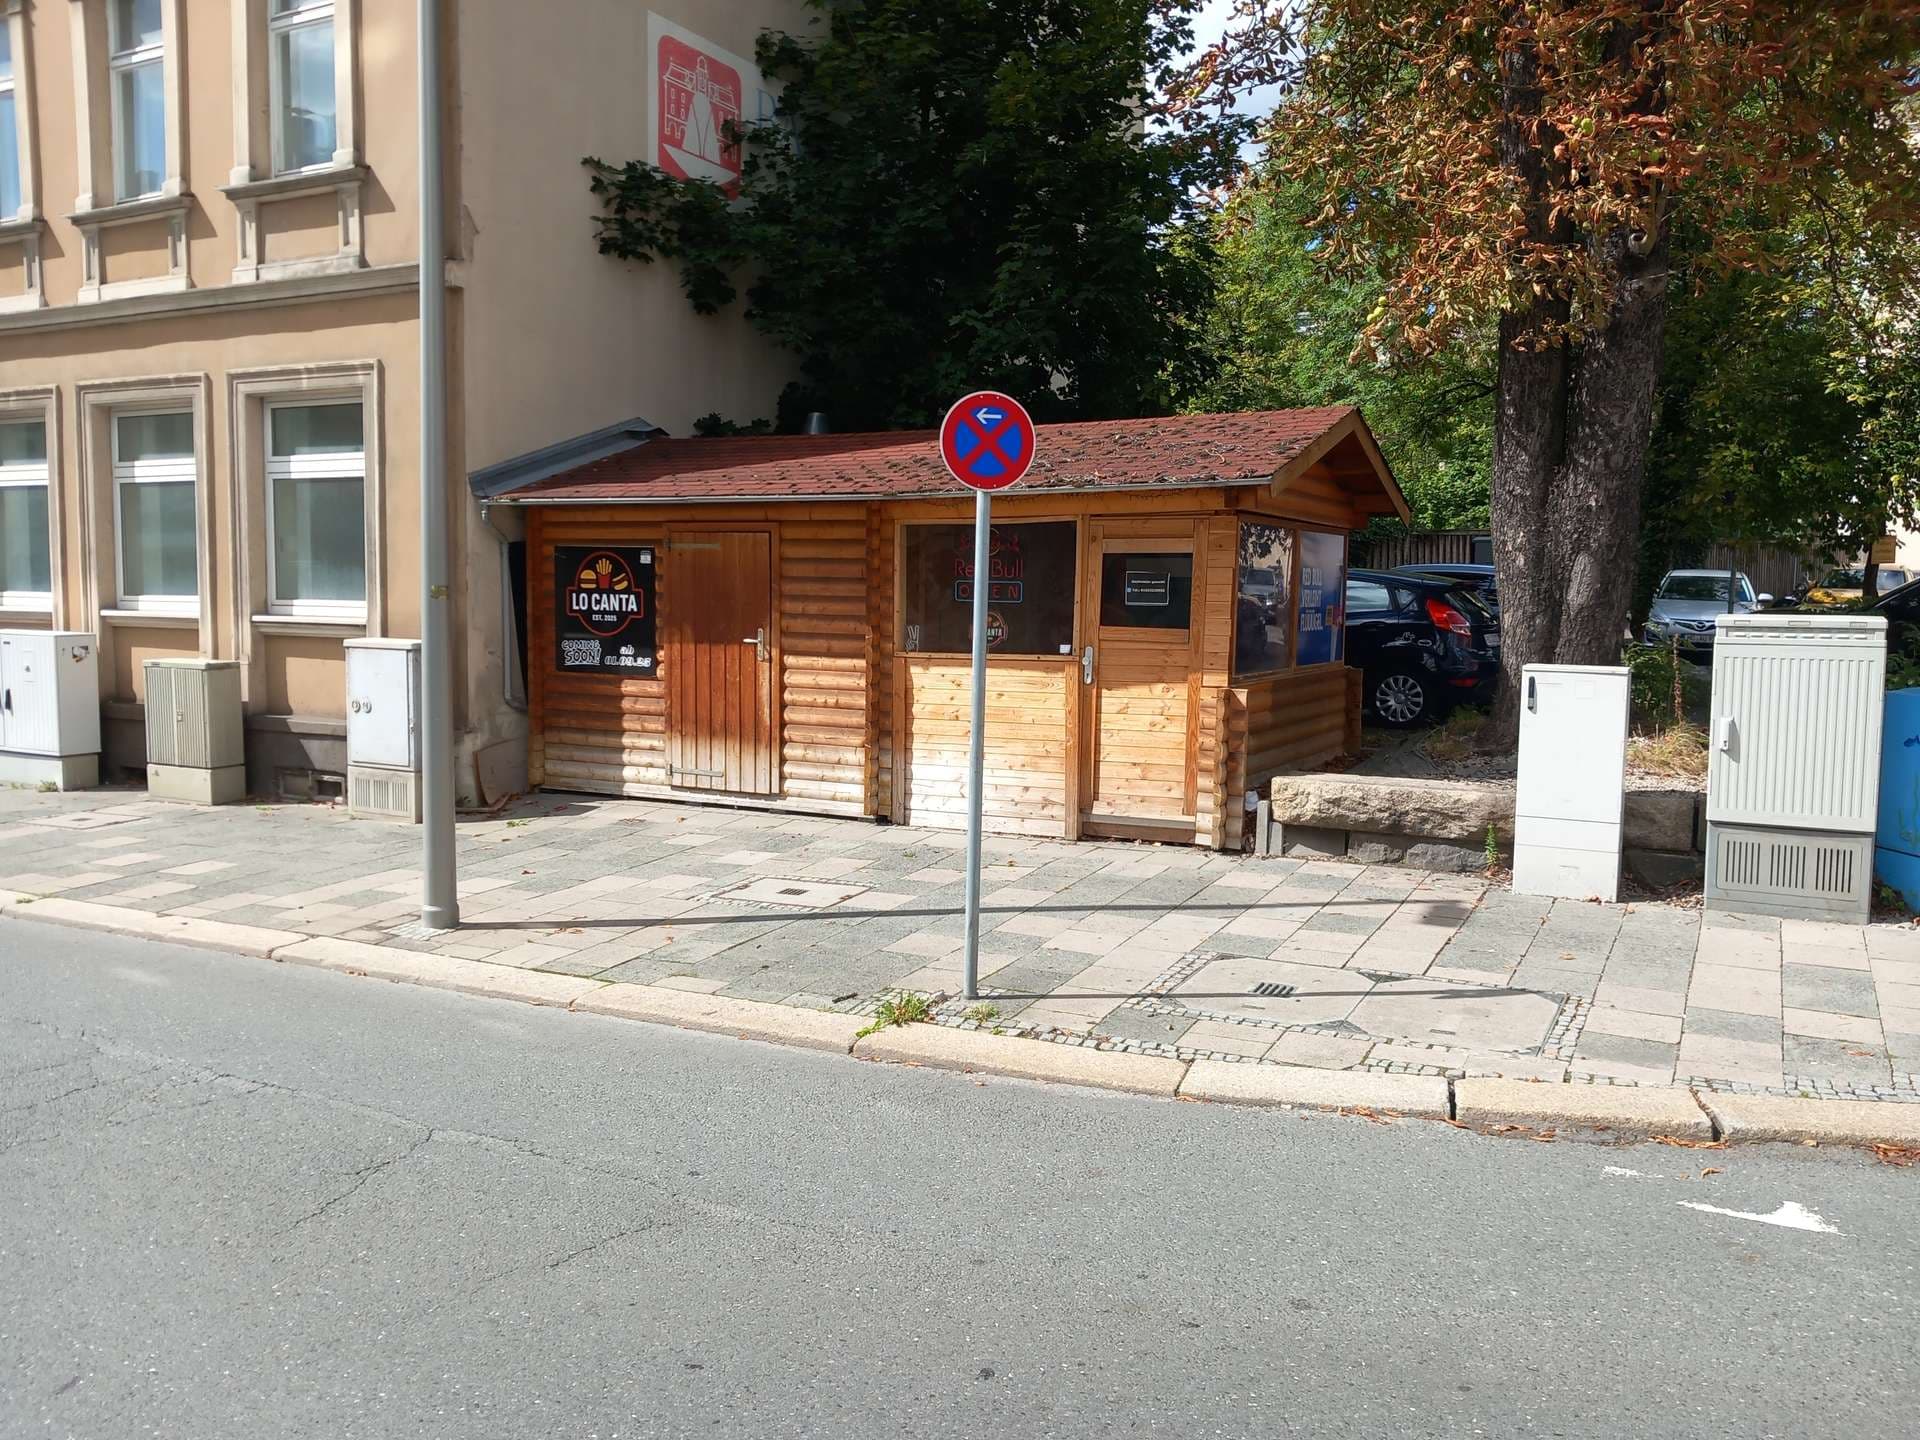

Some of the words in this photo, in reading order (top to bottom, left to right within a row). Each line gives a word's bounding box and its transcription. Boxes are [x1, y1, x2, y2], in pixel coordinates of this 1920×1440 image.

[991, 559, 1024, 578] Bull
[959, 585, 1019, 599] OEN
[572, 592, 589, 611] LO
[591, 593, 638, 612] CANTA
[561, 639, 601, 650] COMING
[564, 648, 602, 664] SOON!
